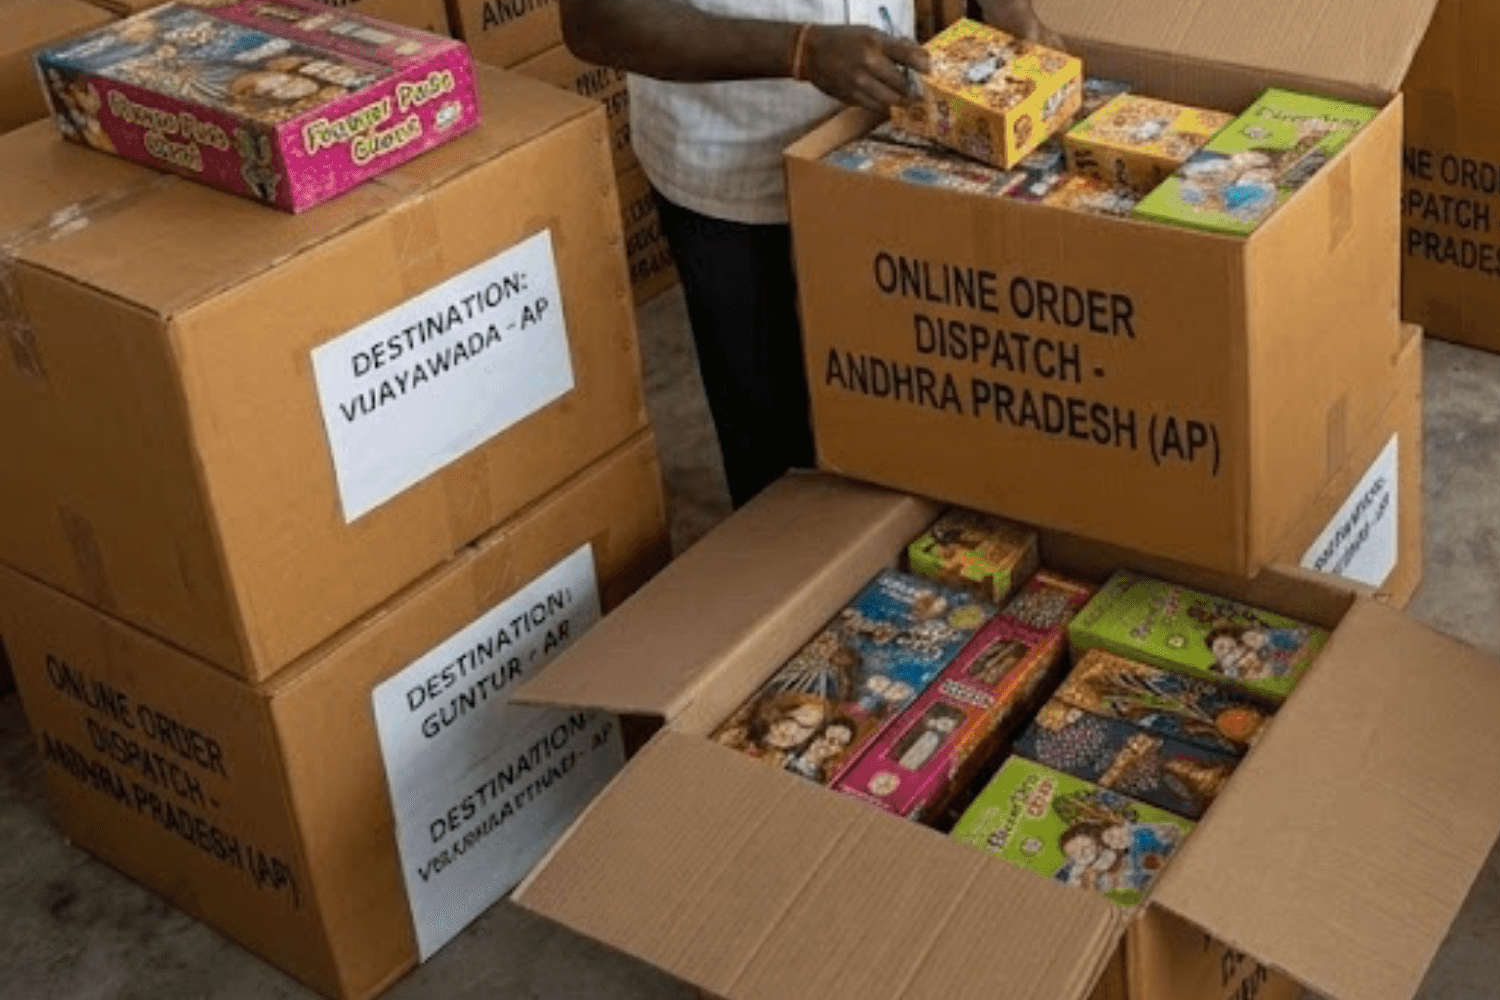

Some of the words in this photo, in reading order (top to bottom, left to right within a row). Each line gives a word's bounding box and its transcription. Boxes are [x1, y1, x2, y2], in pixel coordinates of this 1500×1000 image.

[1401, 188, 1490, 233] PATCH
[352, 272, 529, 378] DESTINATION:
[521, 296, 549, 330] AP
[874, 252, 1000, 314] ONLINE
[1009, 276, 1137, 340] ORDER
[913, 313, 1082, 384] DISPATCH
[825, 347, 963, 416] ANDHRA
[970, 378, 1138, 450] PRADESH
[1148, 413, 1221, 478] (AP)
[422, 656, 523, 739] GUNTUR
